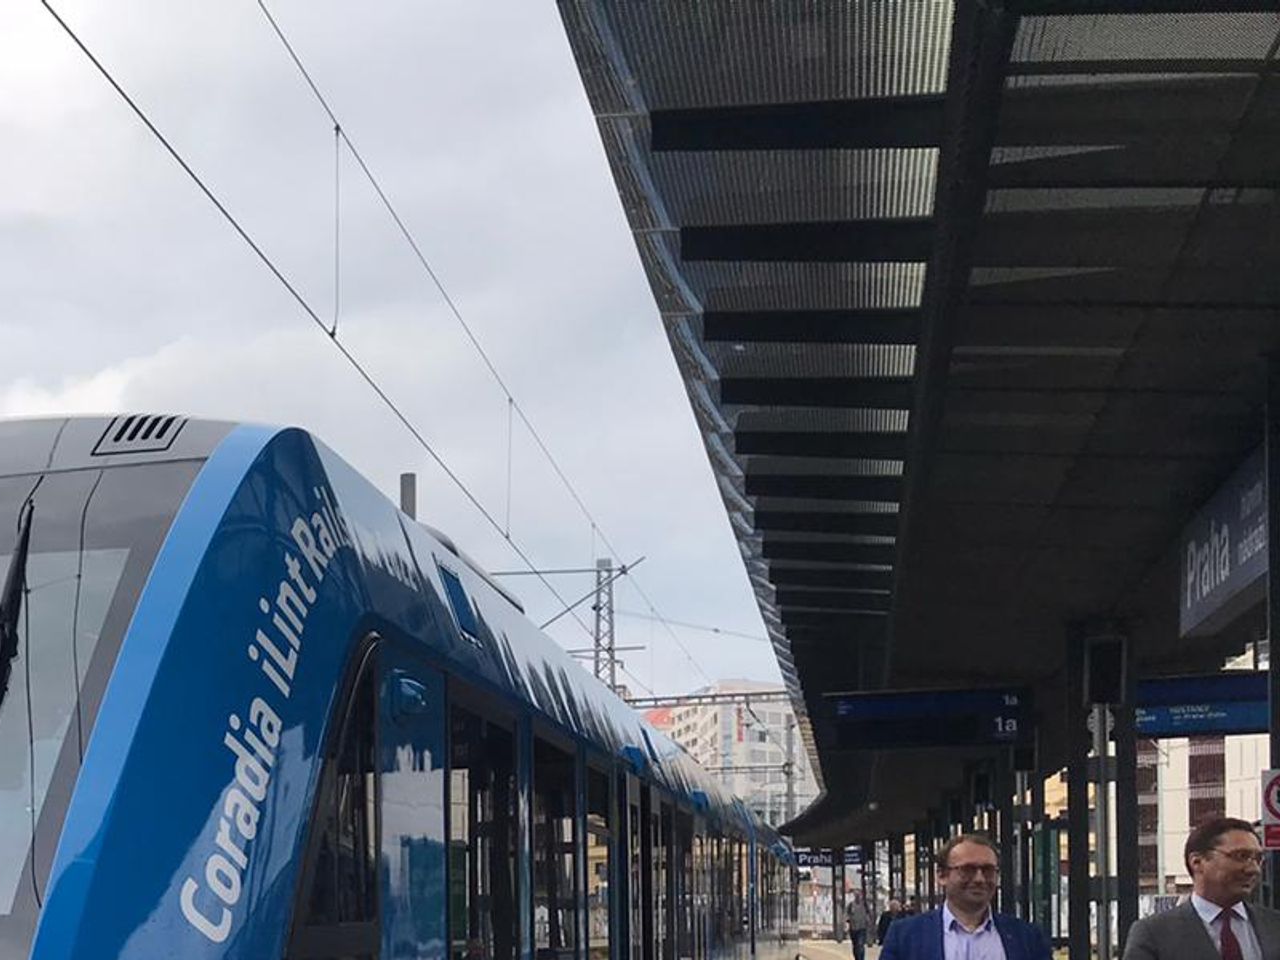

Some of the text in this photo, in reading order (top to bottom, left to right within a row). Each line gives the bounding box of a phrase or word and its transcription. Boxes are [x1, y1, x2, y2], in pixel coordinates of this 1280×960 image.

[1186, 519, 1230, 609] Praha
[180, 696, 282, 943] Coradia
[248, 551, 317, 698] iLint
[994, 716, 1018, 732] 1a
